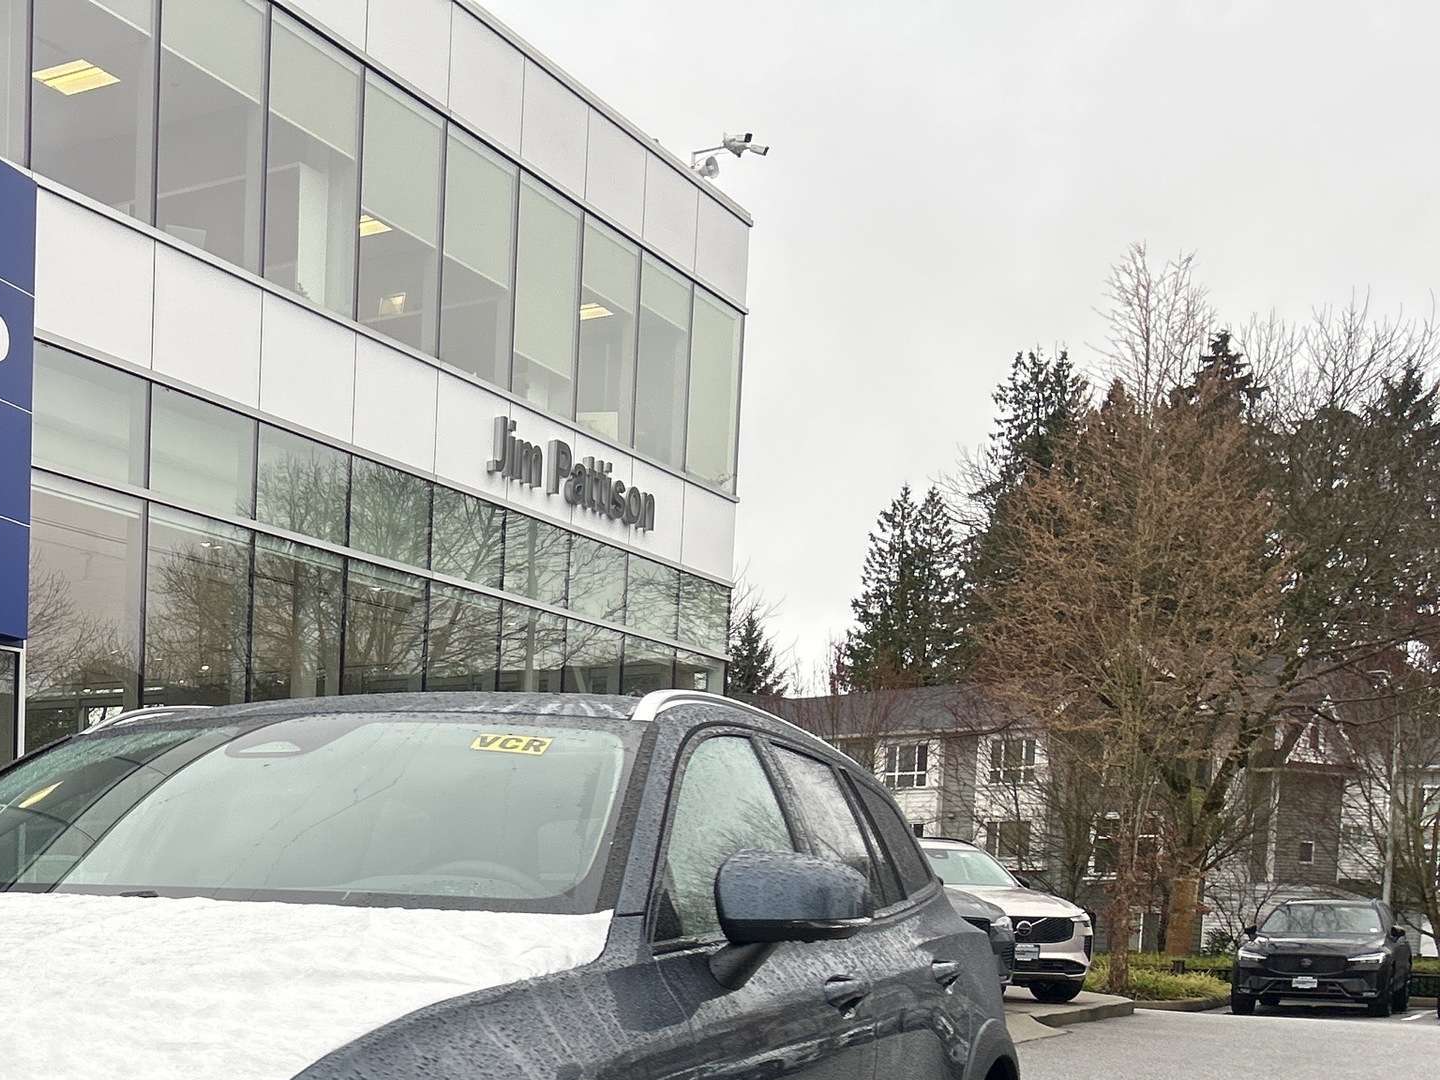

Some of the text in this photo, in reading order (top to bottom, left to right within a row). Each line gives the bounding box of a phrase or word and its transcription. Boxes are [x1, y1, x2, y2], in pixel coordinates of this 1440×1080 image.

[486, 416, 655, 531] Jim Pattison
[479, 735, 547, 752] VCR
